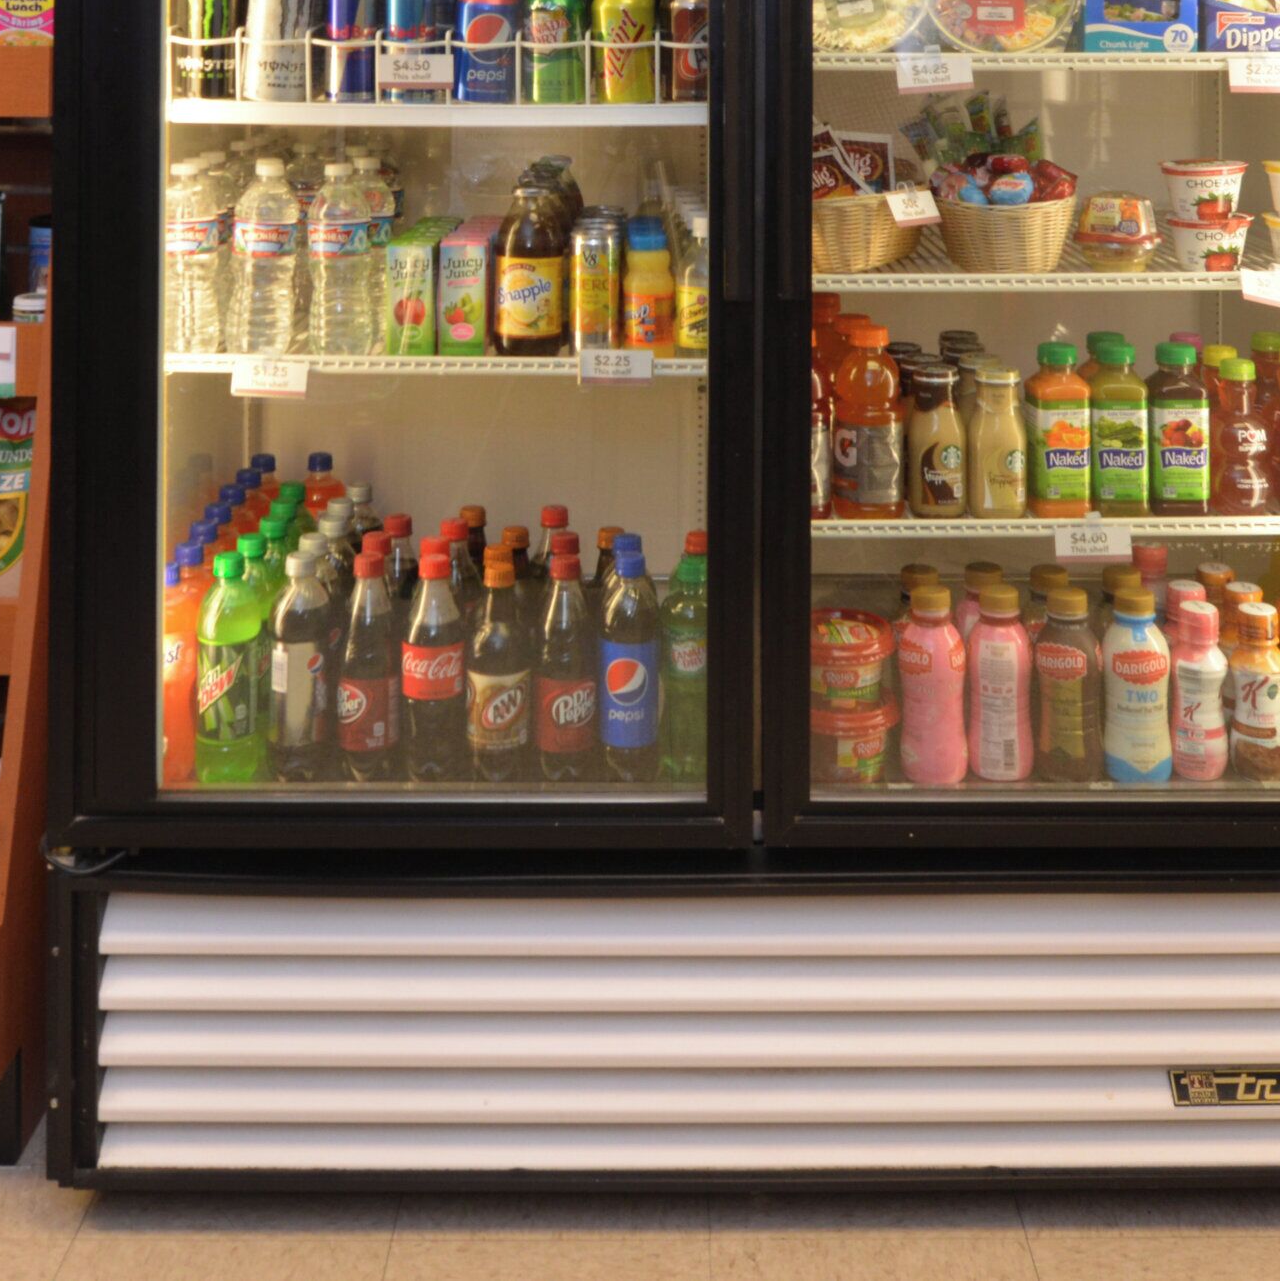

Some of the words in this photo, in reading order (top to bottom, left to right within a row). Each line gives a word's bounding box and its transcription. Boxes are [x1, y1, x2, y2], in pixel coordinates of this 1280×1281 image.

[6, 2, 42, 12] Lunch
[1171, 29, 1188, 42] 70
[1100, 40, 1126, 48] Chunk
[1128, 40, 1149, 49] Light
[393, 60, 430, 71] $4.50
[911, 64, 949, 76] $4.25
[467, 69, 506, 82] pepsi
[443, 257, 483, 271] Juicy
[583, 251, 597, 266] V8
[446, 269, 479, 279] Juice
[497, 279, 551, 304] Snapple
[594, 356, 630, 367] $2.25
[834, 429, 858, 466] G
[1050, 453, 1088, 468] Naked
[1103, 455, 1144, 467] Naked
[1164, 453, 1207, 467] Naked
[1071, 533, 1107, 544] $4.00
[403, 652, 464, 681] Coca-Cola
[1037, 653, 1083, 668] DARIGOLD
[1115, 658, 1165, 673] DARIGOLD
[1127, 690, 1158, 702] TWO
[608, 708, 644, 723] pepsi
